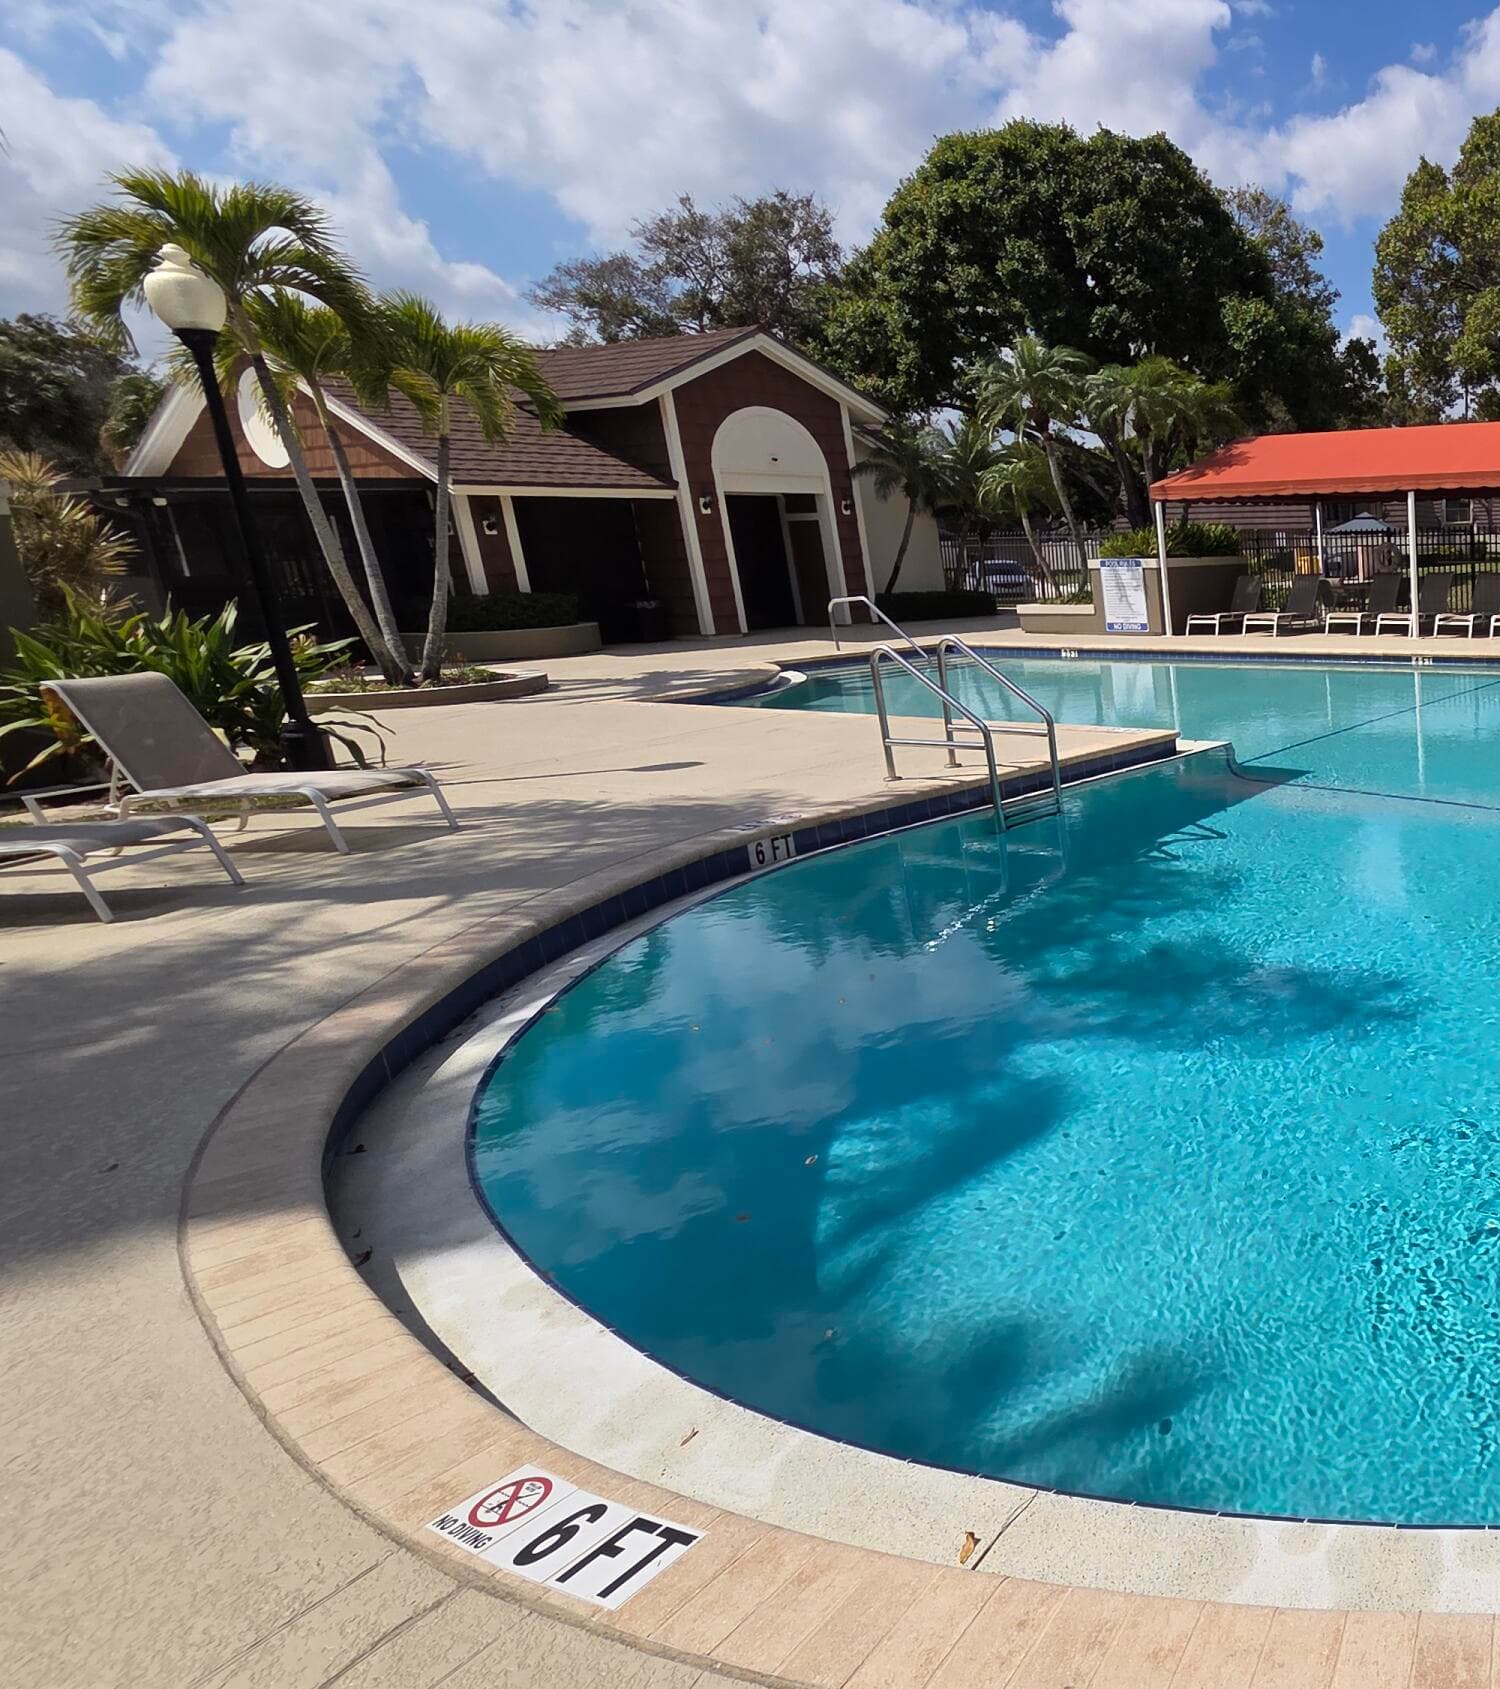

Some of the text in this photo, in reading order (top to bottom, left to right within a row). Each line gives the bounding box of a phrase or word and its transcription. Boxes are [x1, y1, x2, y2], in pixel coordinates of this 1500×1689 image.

[755, 833, 791, 865] 6 FT
[431, 1514, 493, 1549] NO DIVING
[513, 1503, 699, 1599] 6 FT
